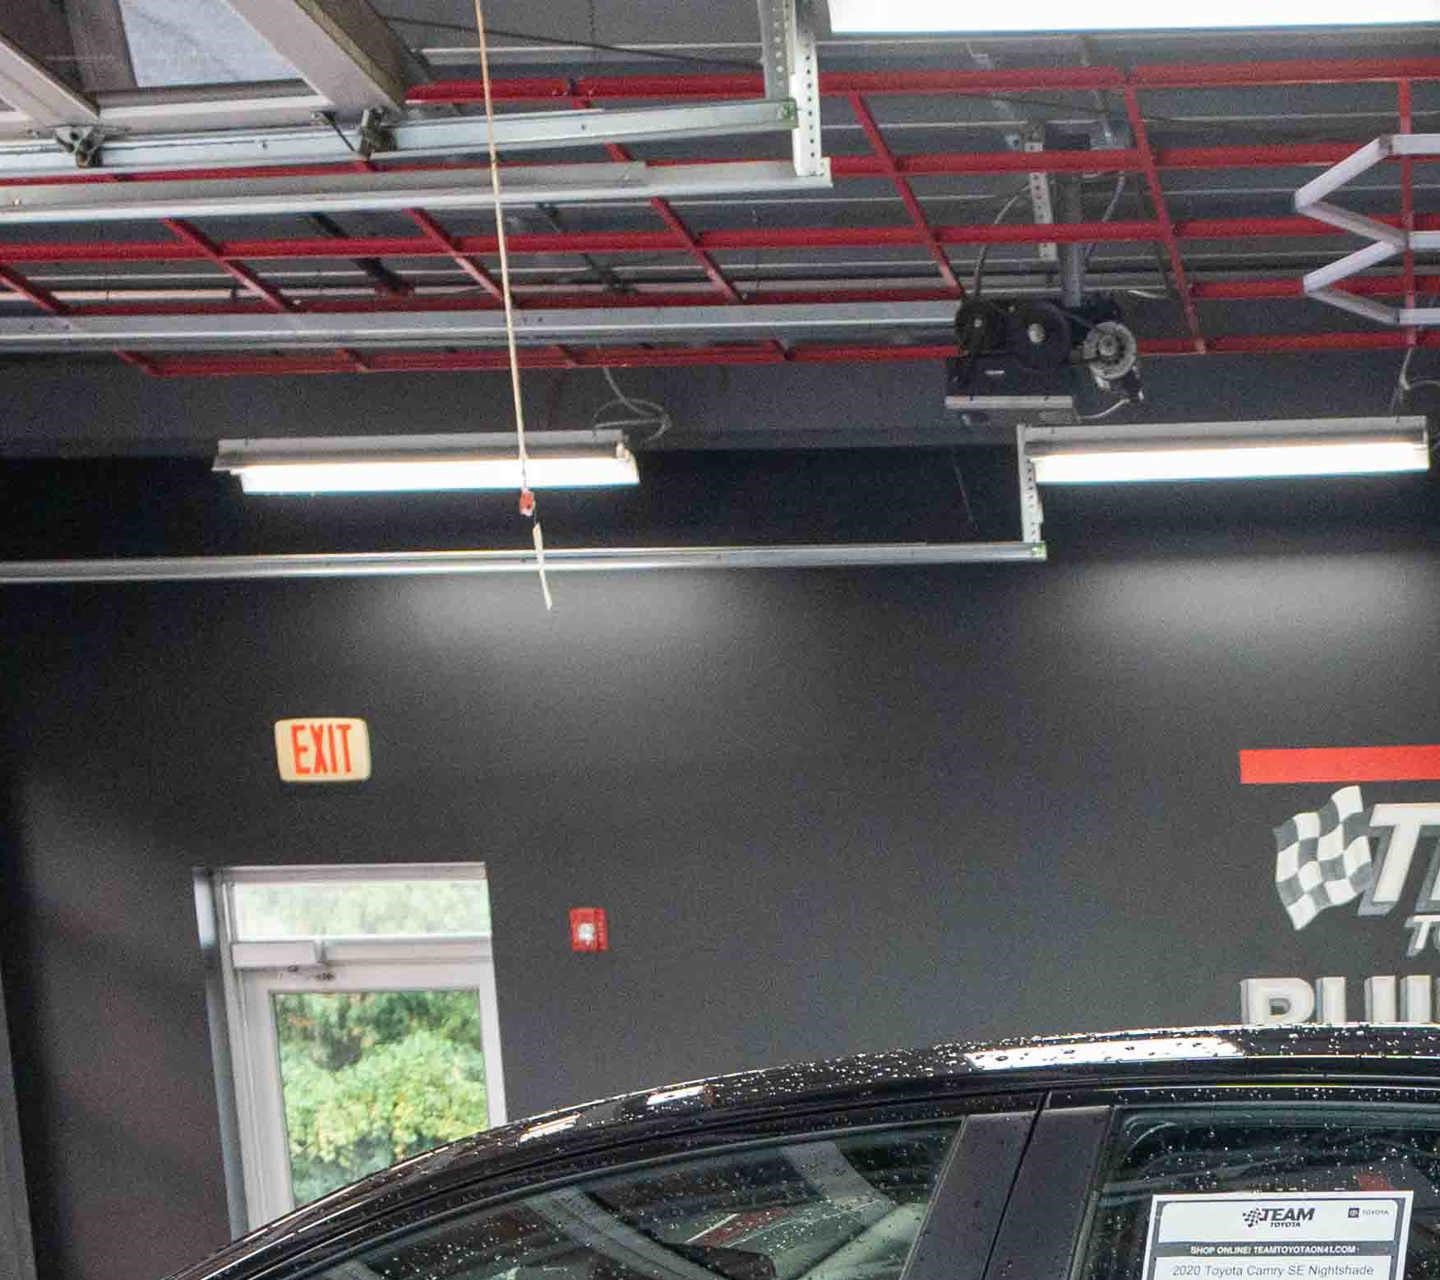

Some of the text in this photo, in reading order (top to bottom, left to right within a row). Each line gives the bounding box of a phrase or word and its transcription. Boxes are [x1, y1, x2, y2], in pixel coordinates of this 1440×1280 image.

[291, 724, 351, 774] EXIT
[1260, 1208, 1315, 1221] TEAM
[1191, 1246, 1215, 1255] SHOP
[1217, 1246, 1251, 1255] ONLINE!
[1172, 1263, 1374, 1279] 2020 Toyota Camry SE Nightshade
